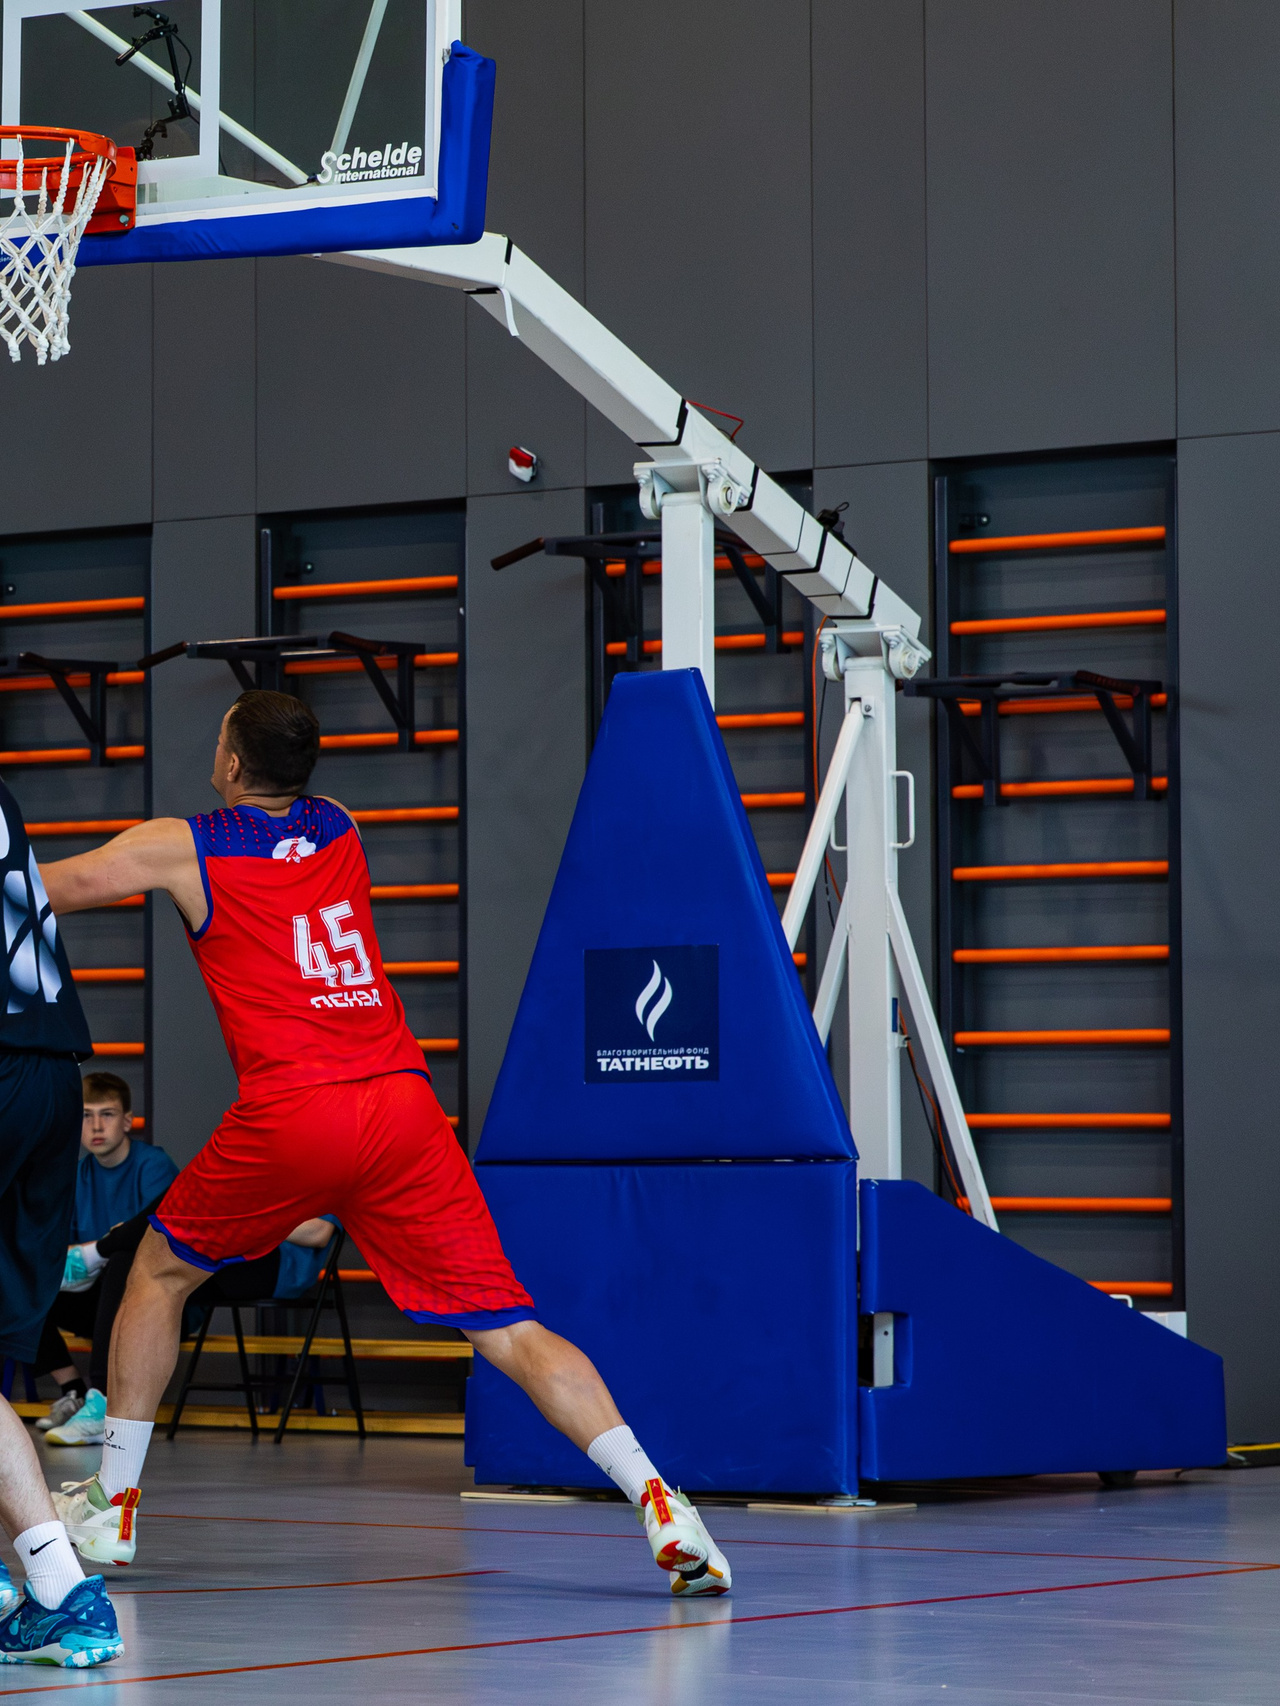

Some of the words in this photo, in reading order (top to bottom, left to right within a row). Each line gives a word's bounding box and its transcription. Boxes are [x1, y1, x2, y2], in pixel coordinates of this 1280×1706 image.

[317, 142, 422, 184] Schelde
[334, 163, 419, 183] international
[292, 900, 375, 988] 45
[597, 1047, 685, 1057] БЛАГОТВОРИТЕЛЬНЫЙ
[686, 1047, 709, 1055] ФОНД
[597, 1056, 709, 1072] ТАТНЕФТЬ
